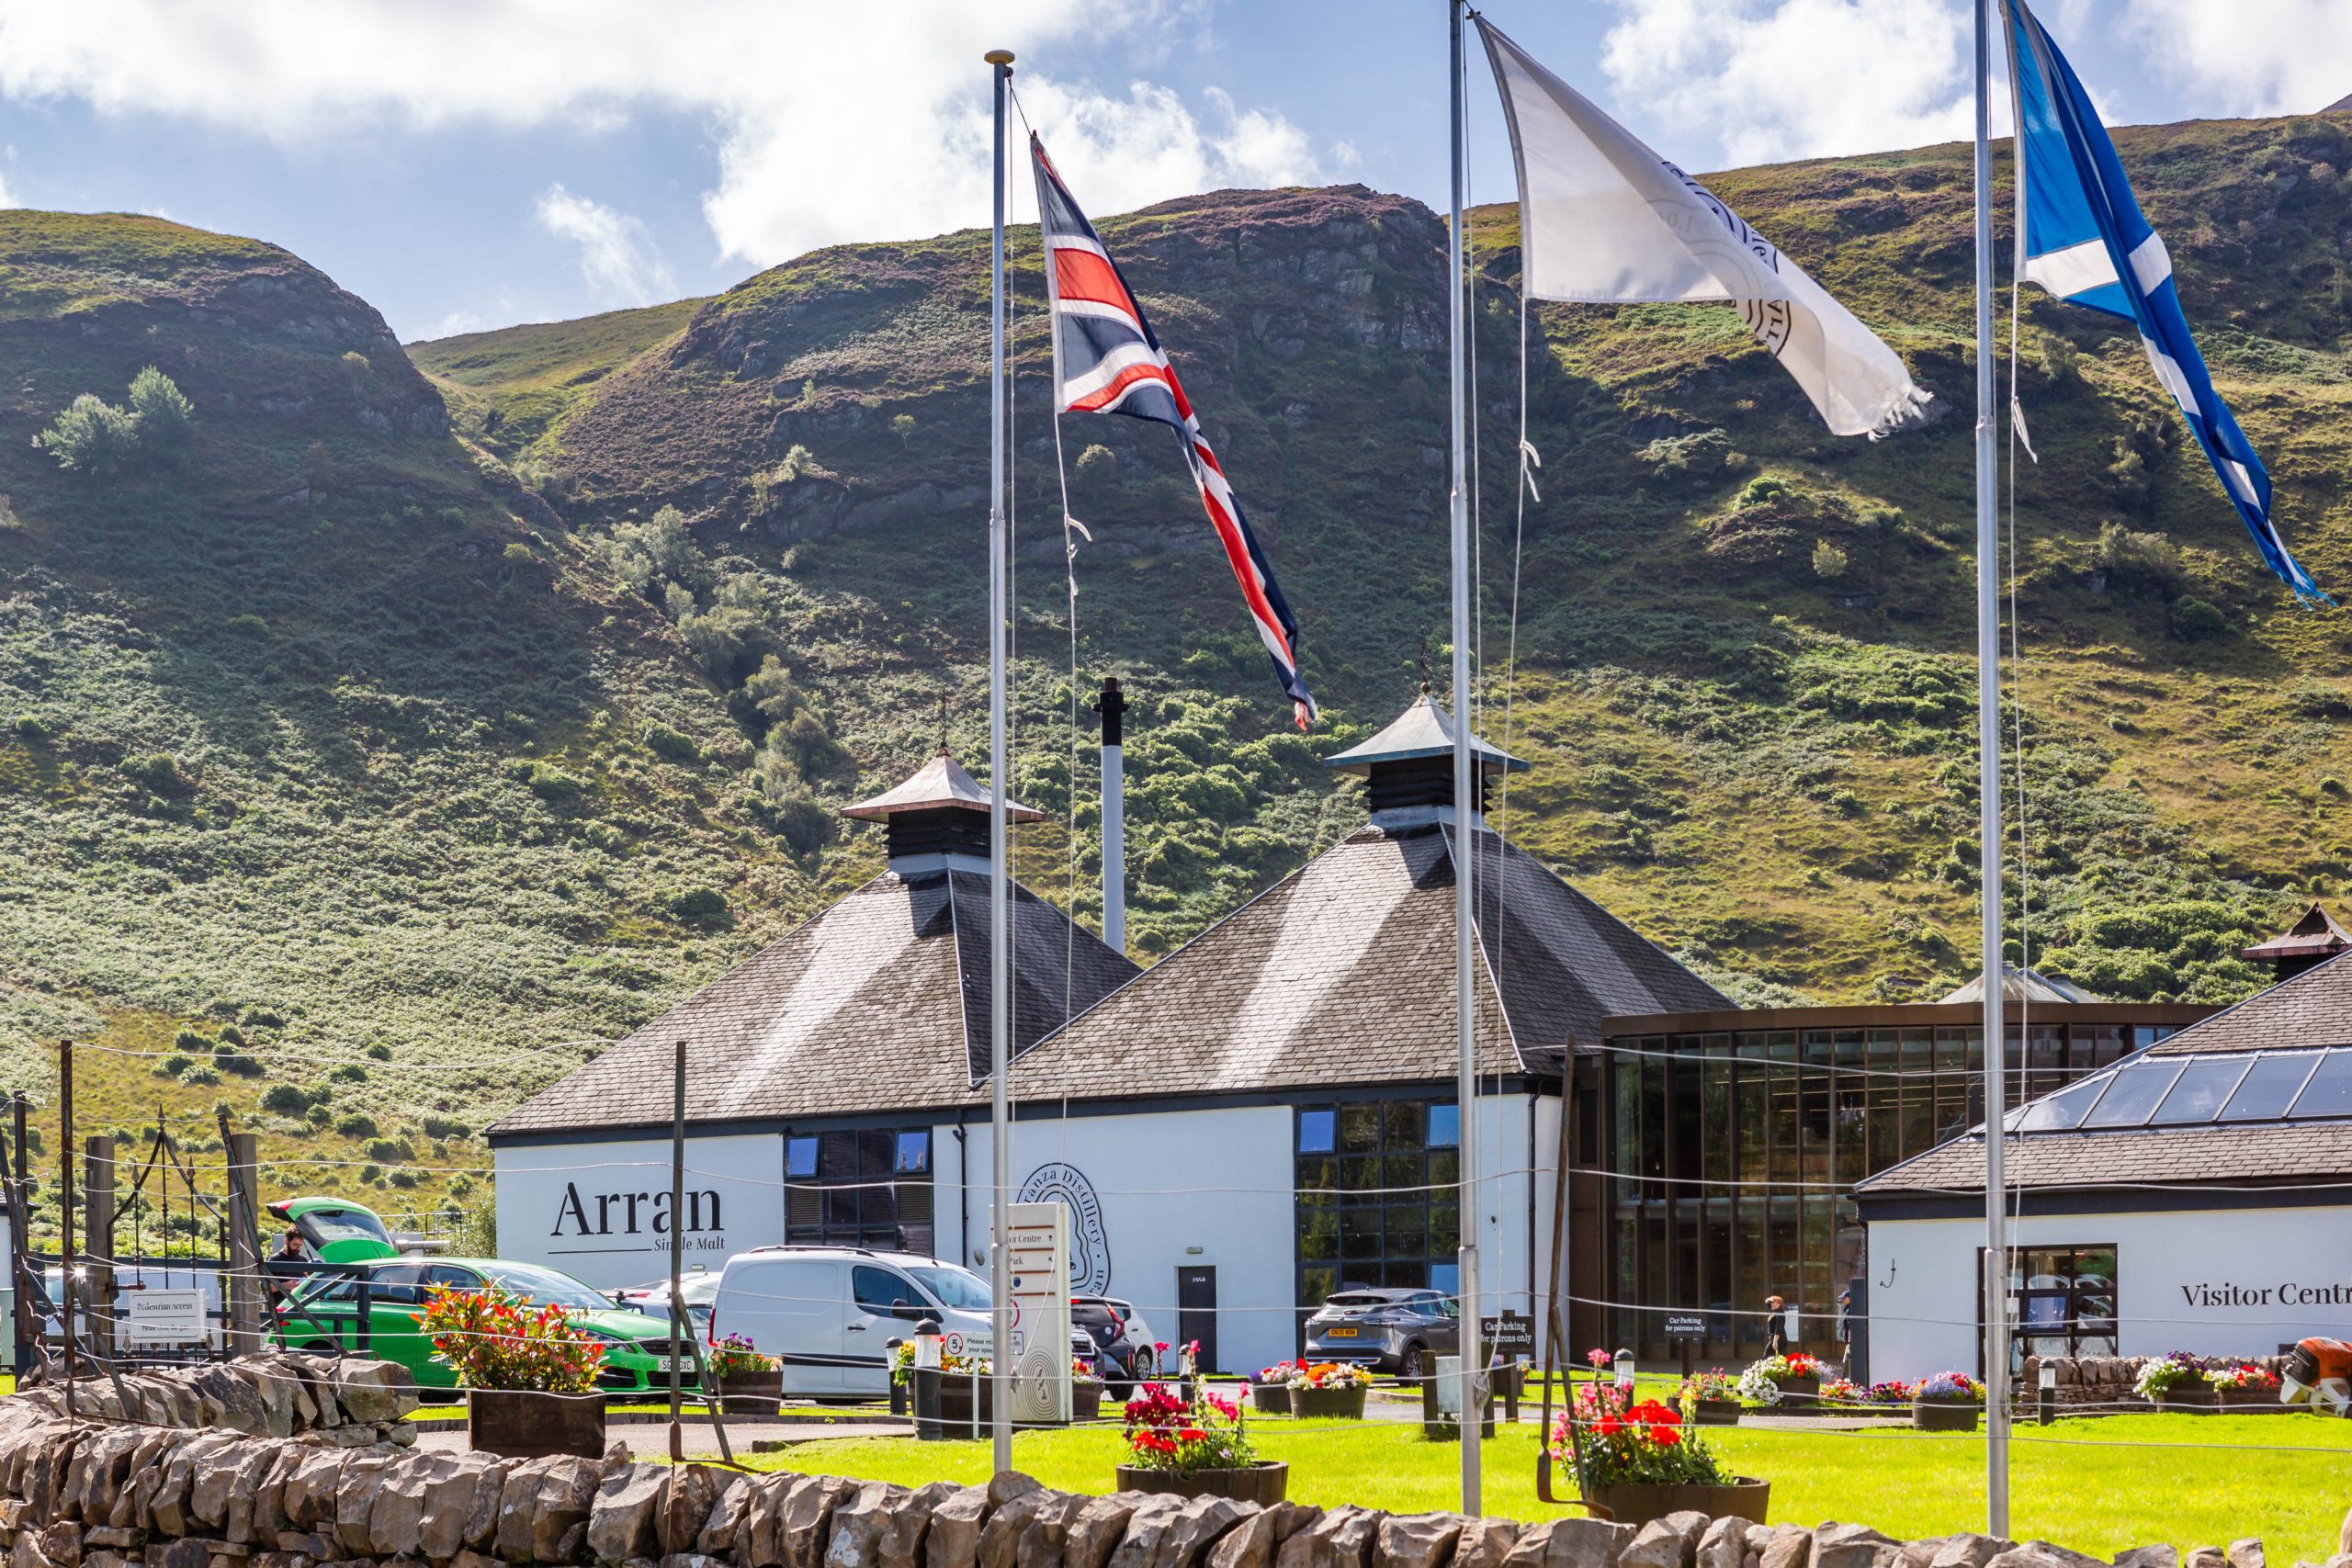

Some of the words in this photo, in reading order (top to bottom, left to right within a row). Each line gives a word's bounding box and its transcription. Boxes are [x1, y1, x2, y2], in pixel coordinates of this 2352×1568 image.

[550, 1182, 724, 1235] Arran
[1061, 1169, 1102, 1247] Distillery
[654, 1237, 692, 1251] Sinle
[696, 1236, 725, 1250] Malt
[1018, 1235, 1041, 1243] Centre
[2181, 1282, 2272, 1306] Visitor
[2278, 1283, 2352, 1305] Centr
[137, 1302, 171, 1311] Pedestrian
[172, 1302, 193, 1310] Access
[1485, 1322, 1498, 1331] Car
[1498, 1321, 1526, 1333] Parking
[952, 1339, 958, 1348] 5
[1517, 1333, 1532, 1344] only
